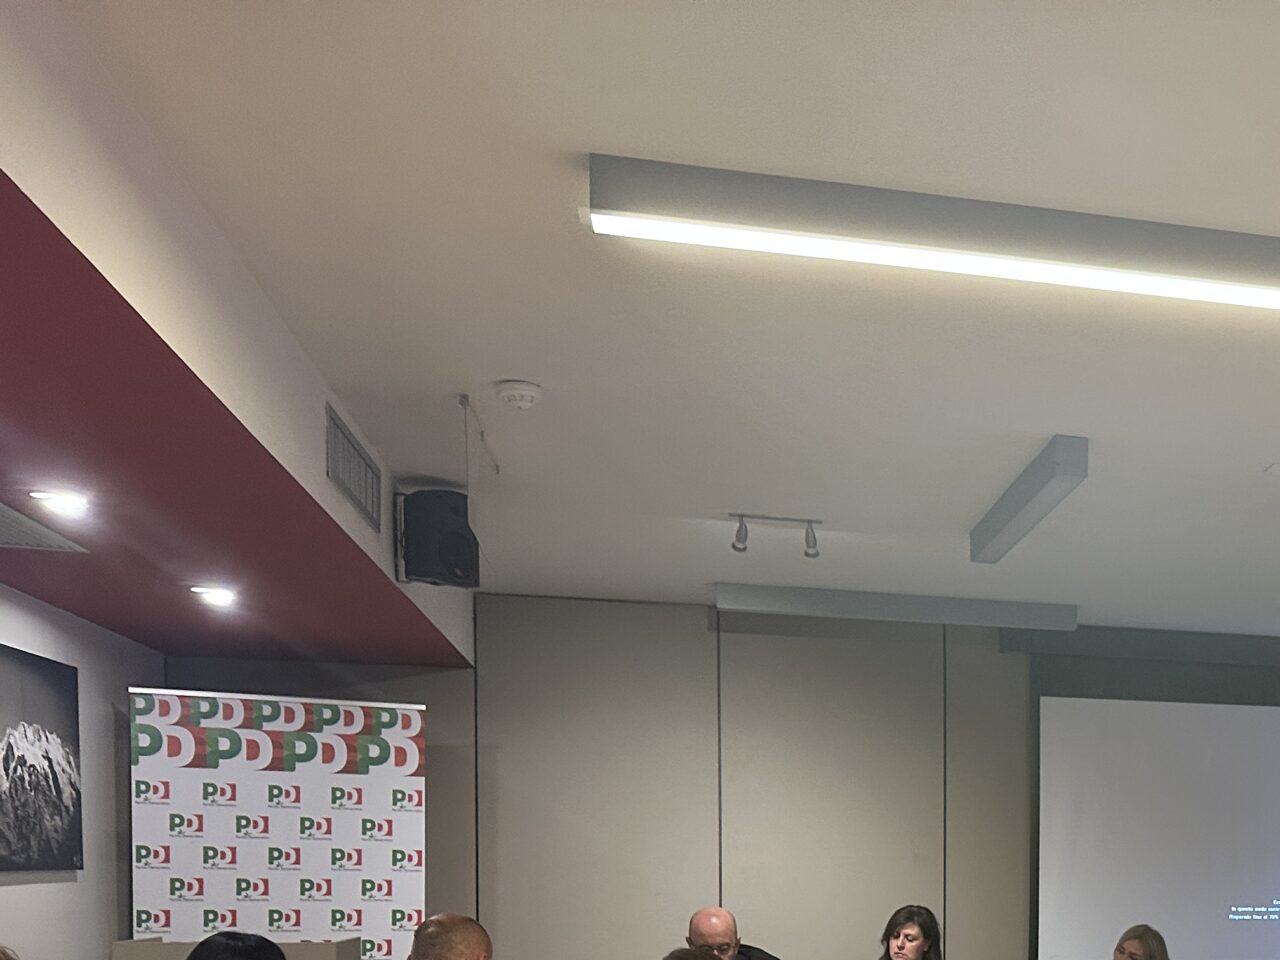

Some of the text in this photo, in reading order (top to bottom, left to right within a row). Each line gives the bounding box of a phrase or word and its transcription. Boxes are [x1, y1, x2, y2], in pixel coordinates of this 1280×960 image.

[130, 694, 181, 725] PD
[191, 696, 245, 728] PD
[254, 699, 305, 732] PD
[314, 702, 364, 734] PD
[373, 705, 422, 737] PD
[131, 724, 195, 767] PD
[207, 727, 273, 770] PD
[284, 731, 347, 773] PD
[357, 735, 421, 776] PD
[135, 780, 170, 799] PD
[203, 783, 237, 801] PD
[268, 785, 301, 803] PD
[331, 787, 363, 805] PD
[392, 789, 423, 807] PD
[169, 814, 204, 832] PD
[236, 815, 269, 833] PD
[300, 817, 332, 835] PD
[362, 818, 393, 836] PD
[135, 845, 171, 864] PD
[203, 846, 237, 864] PD
[268, 847, 301, 865] PD
[331, 848, 363, 866] PD
[392, 849, 423, 867] PD
[170, 877, 204, 896] PD
[236, 878, 269, 896] PD
[300, 879, 332, 896] PD
[361, 879, 393, 896] PD
[136, 909, 171, 928] PD
[203, 909, 237, 927] PD
[268, 909, 301, 926] PD
[331, 909, 363, 926] PD
[392, 909, 423, 926] PD
[361, 939, 393, 956] PD
